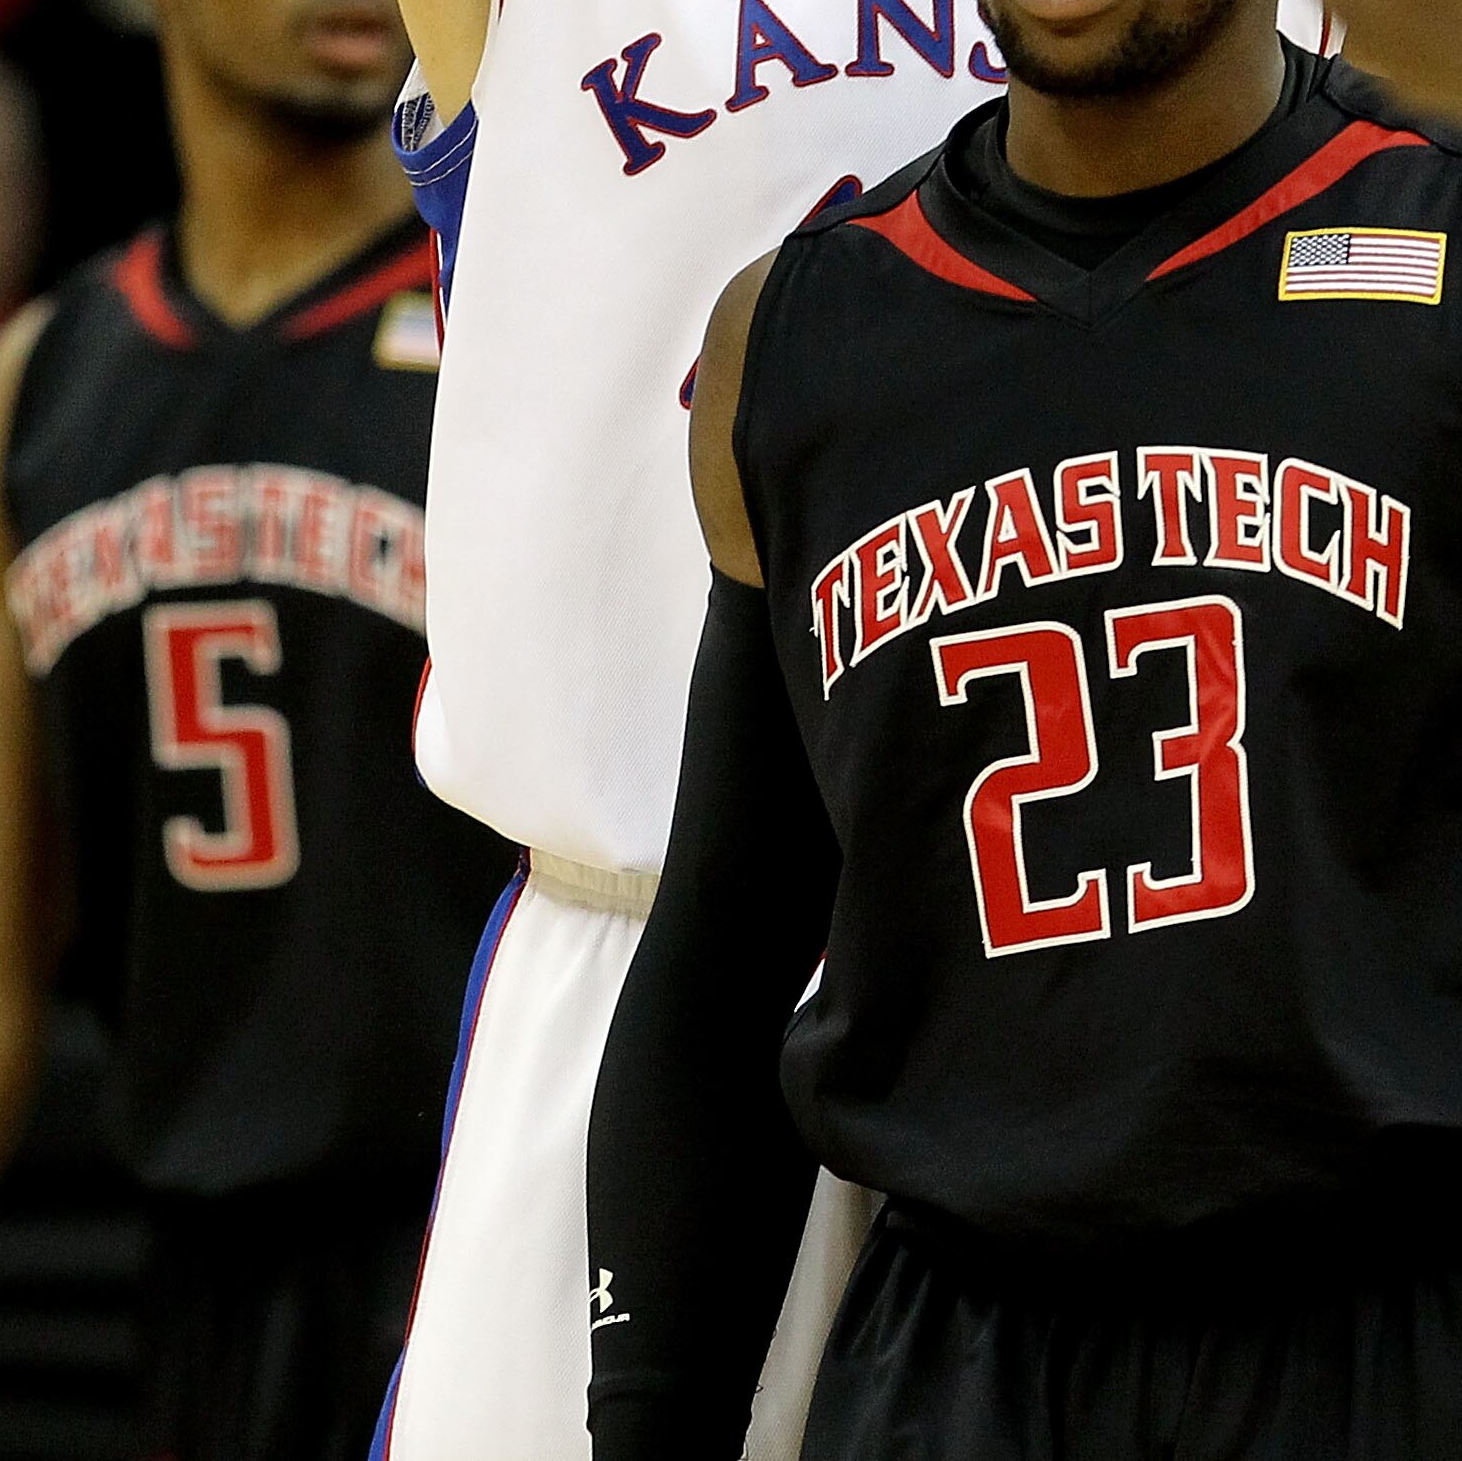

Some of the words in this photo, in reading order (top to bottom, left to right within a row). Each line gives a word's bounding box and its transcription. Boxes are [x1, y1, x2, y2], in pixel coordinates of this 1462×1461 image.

[4, 464, 243, 676] TEXAS
[809, 450, 1124, 701] TEXAS
[1136, 445, 1411, 631] TECH
[142, 598, 303, 893] 5
[929, 593, 1256, 959] 23
